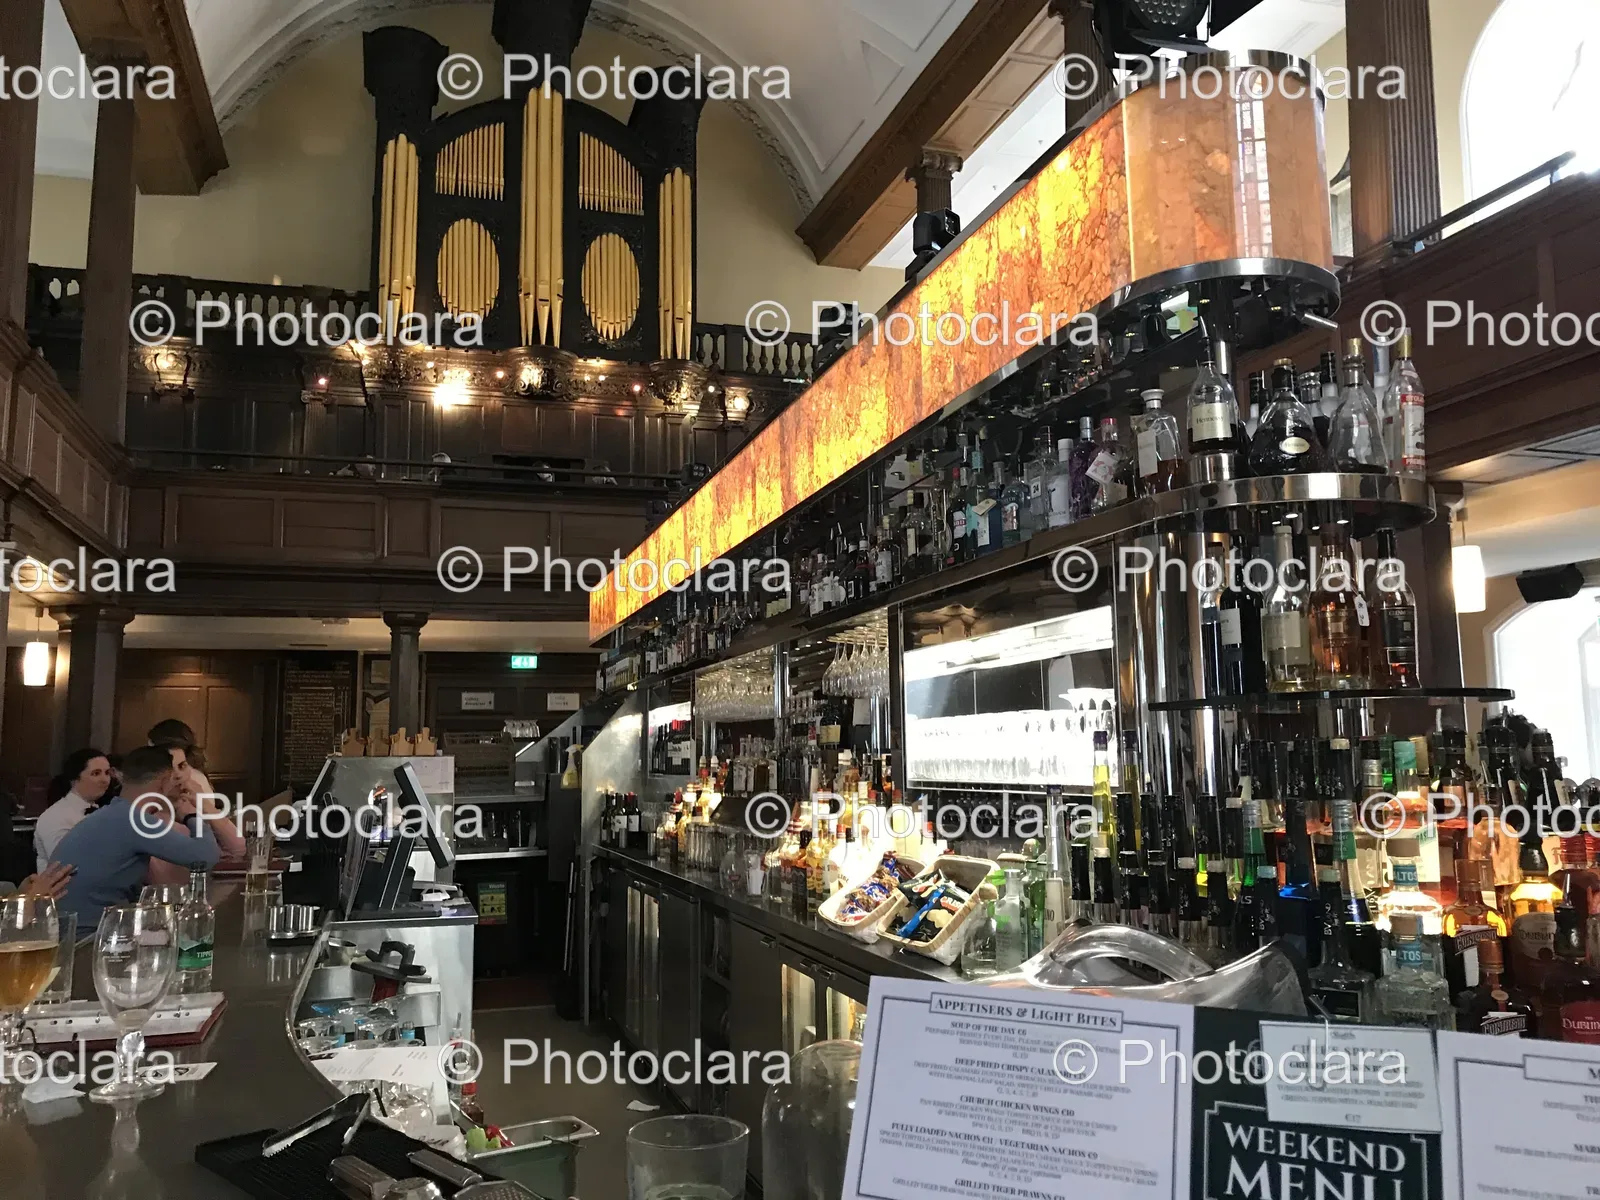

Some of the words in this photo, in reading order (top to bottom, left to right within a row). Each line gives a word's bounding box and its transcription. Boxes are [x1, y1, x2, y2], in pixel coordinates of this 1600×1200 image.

[936, 999, 1013, 1016] APPETISERS
[1016, 1007, 1028, 1018] &
[1032, 1008, 1074, 1022] LIGHT
[1077, 1013, 1117, 1027] BITES
[951, 1022, 970, 1030] SOUP
[984, 1025, 1000, 1033] THE
[1001, 1027, 1015, 1035] DAY
[955, 1058, 975, 1066] DEEP
[977, 1060, 1000, 1069] FRIED
[1002, 1063, 1029, 1073] CRISPY
[960, 1095, 993, 1106] CHURCH
[995, 1100, 1031, 1111] CHICKEN
[1033, 1105, 1060, 1115] WINGS
[891, 1123, 913, 1132] FULLY
[916, 1126, 947, 1137] LOADED
[948, 1131, 980, 1142] NACHOS
[999, 1139, 1049, 1152] VEGETARIAN
[1052, 1147, 1086, 1158] NACHOS
[1223, 1122, 1406, 1172] WEEKEND
[955, 1179, 990, 1191] GRILLED
[992, 1184, 1016, 1195] TIGER
[1223, 1155, 1404, 1200] MENU
